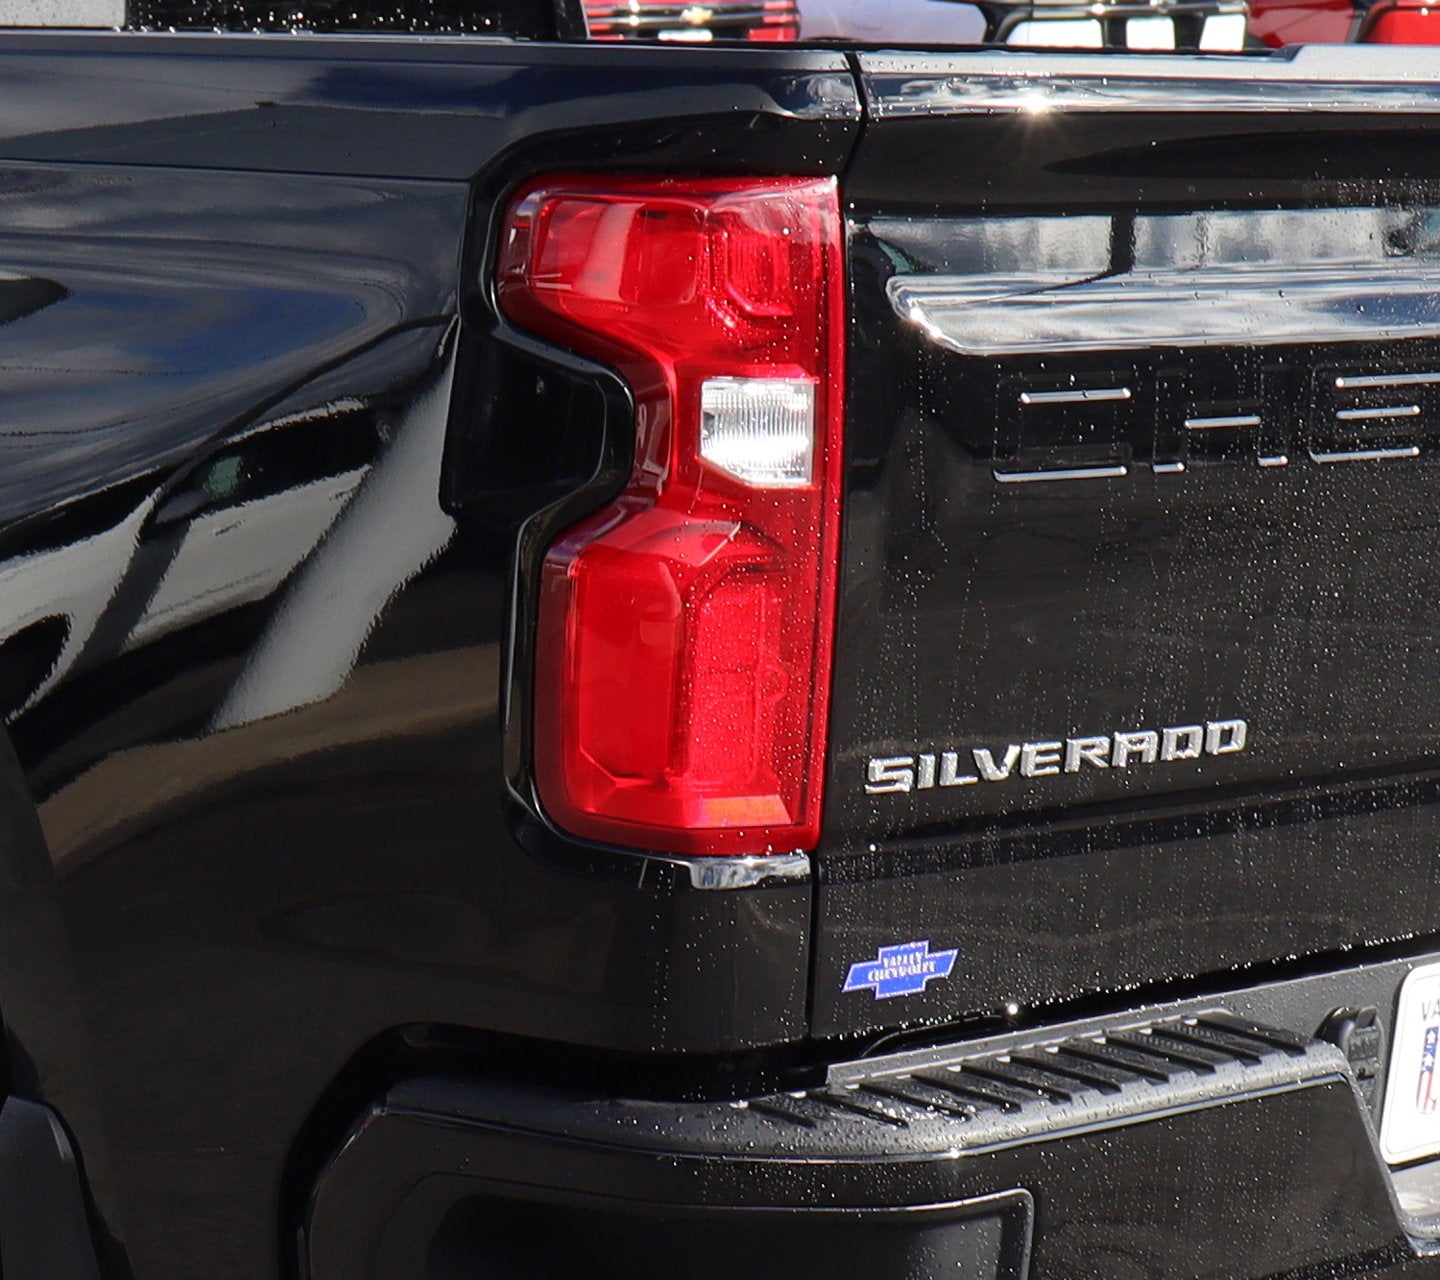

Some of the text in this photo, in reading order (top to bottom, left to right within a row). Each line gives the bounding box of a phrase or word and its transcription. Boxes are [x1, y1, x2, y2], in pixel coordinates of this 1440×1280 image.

[865, 718, 1250, 795] SILVERADO
[867, 960, 937, 982] CHEVROLET
[882, 951, 925, 969] VALLEY
